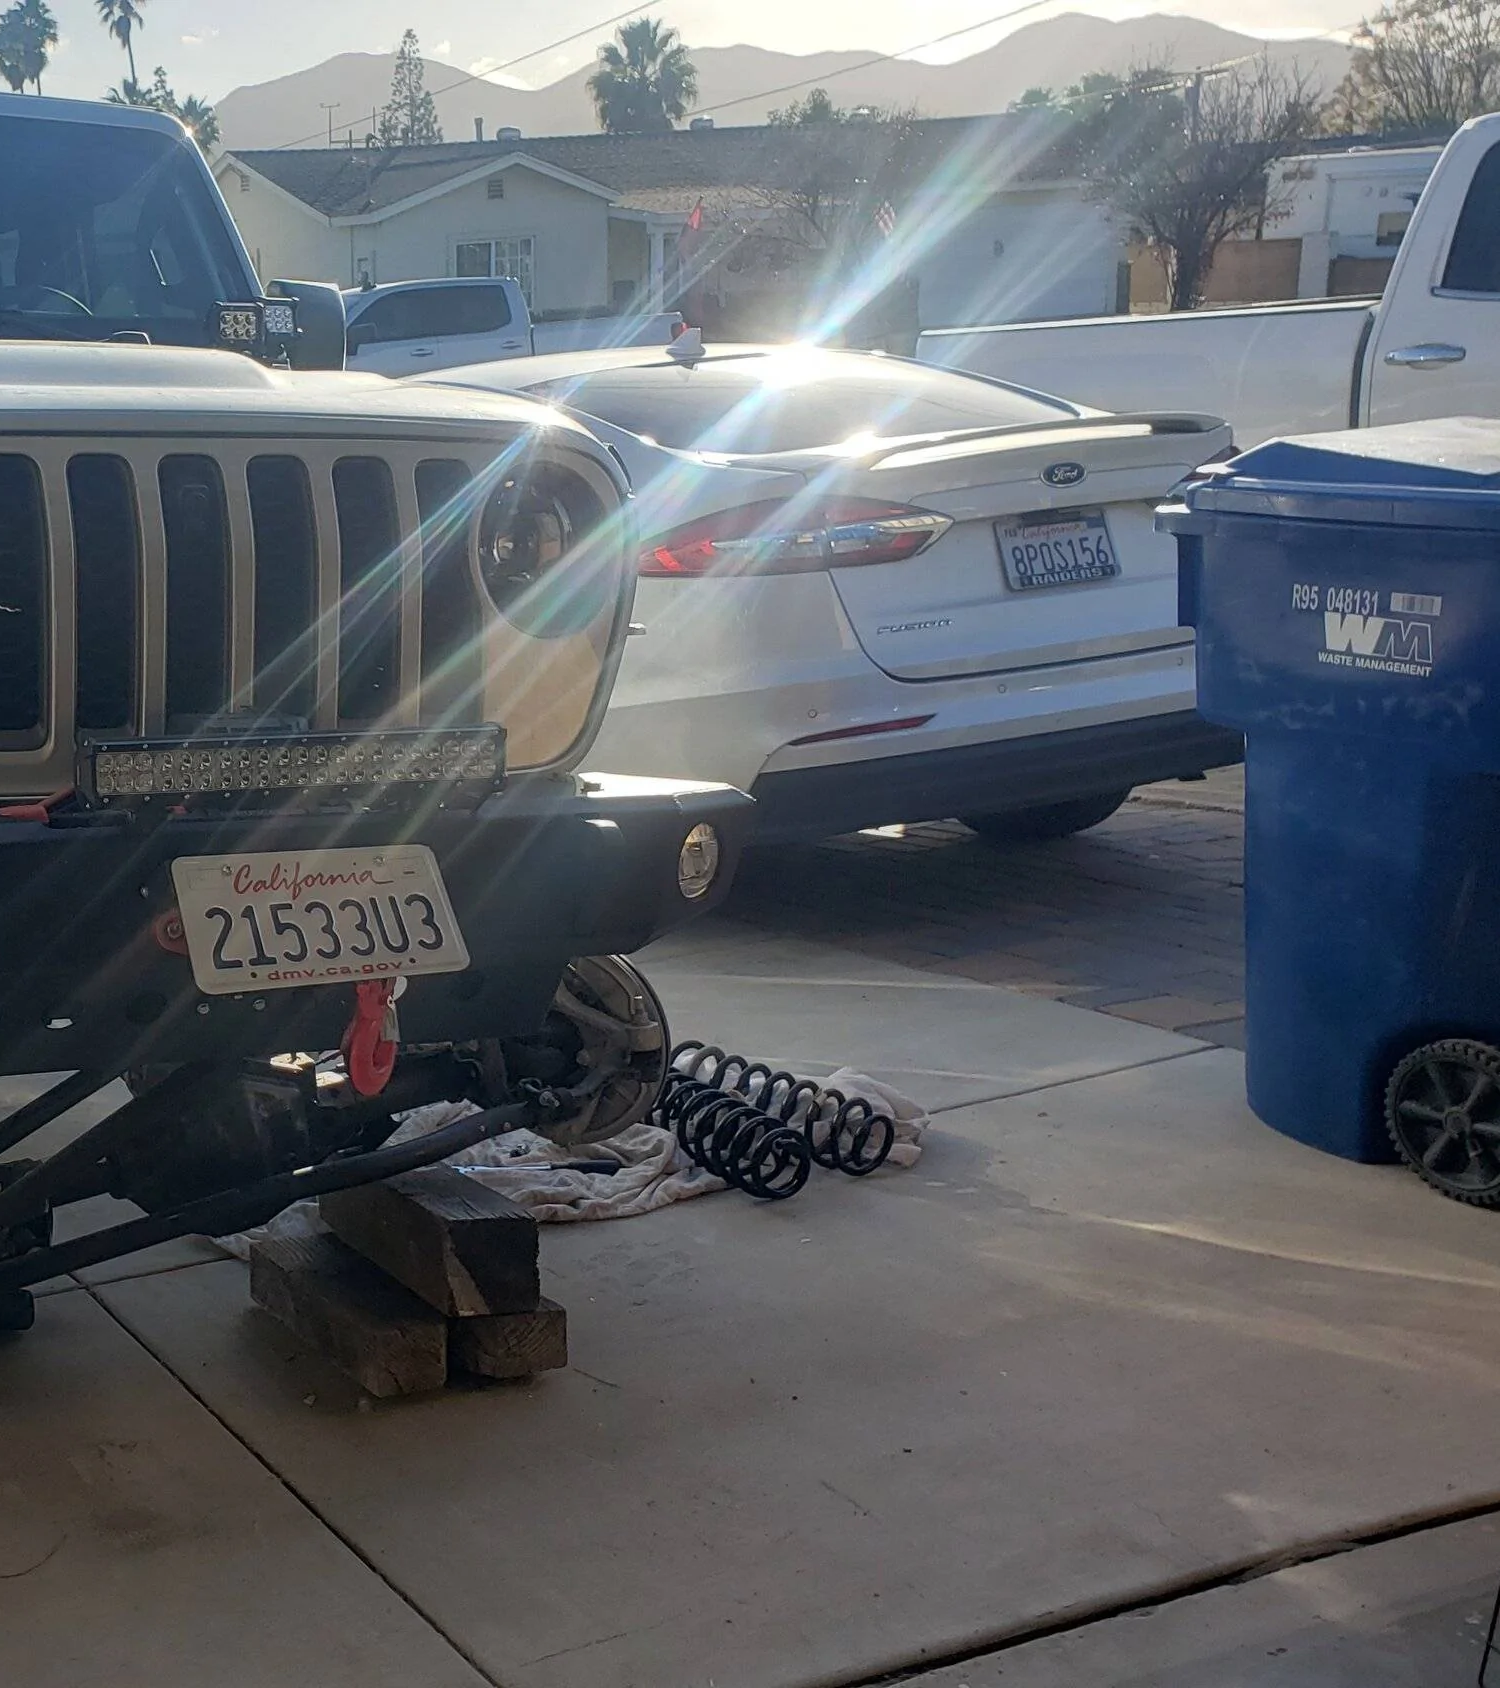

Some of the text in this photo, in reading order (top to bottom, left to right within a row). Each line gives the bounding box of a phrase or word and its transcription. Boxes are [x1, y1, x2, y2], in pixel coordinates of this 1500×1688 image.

[1052, 466, 1078, 481] Ford
[1032, 566, 1102, 585] RAIDERS
[1292, 583, 1378, 616] R95 048131
[1324, 611, 1433, 664] WM
[1318, 651, 1432, 677] WASTE MANAGEMENT
[233, 861, 394, 900] California
[204, 893, 444, 970] 21533U3
[267, 960, 403, 981] dmv.ca.gov
